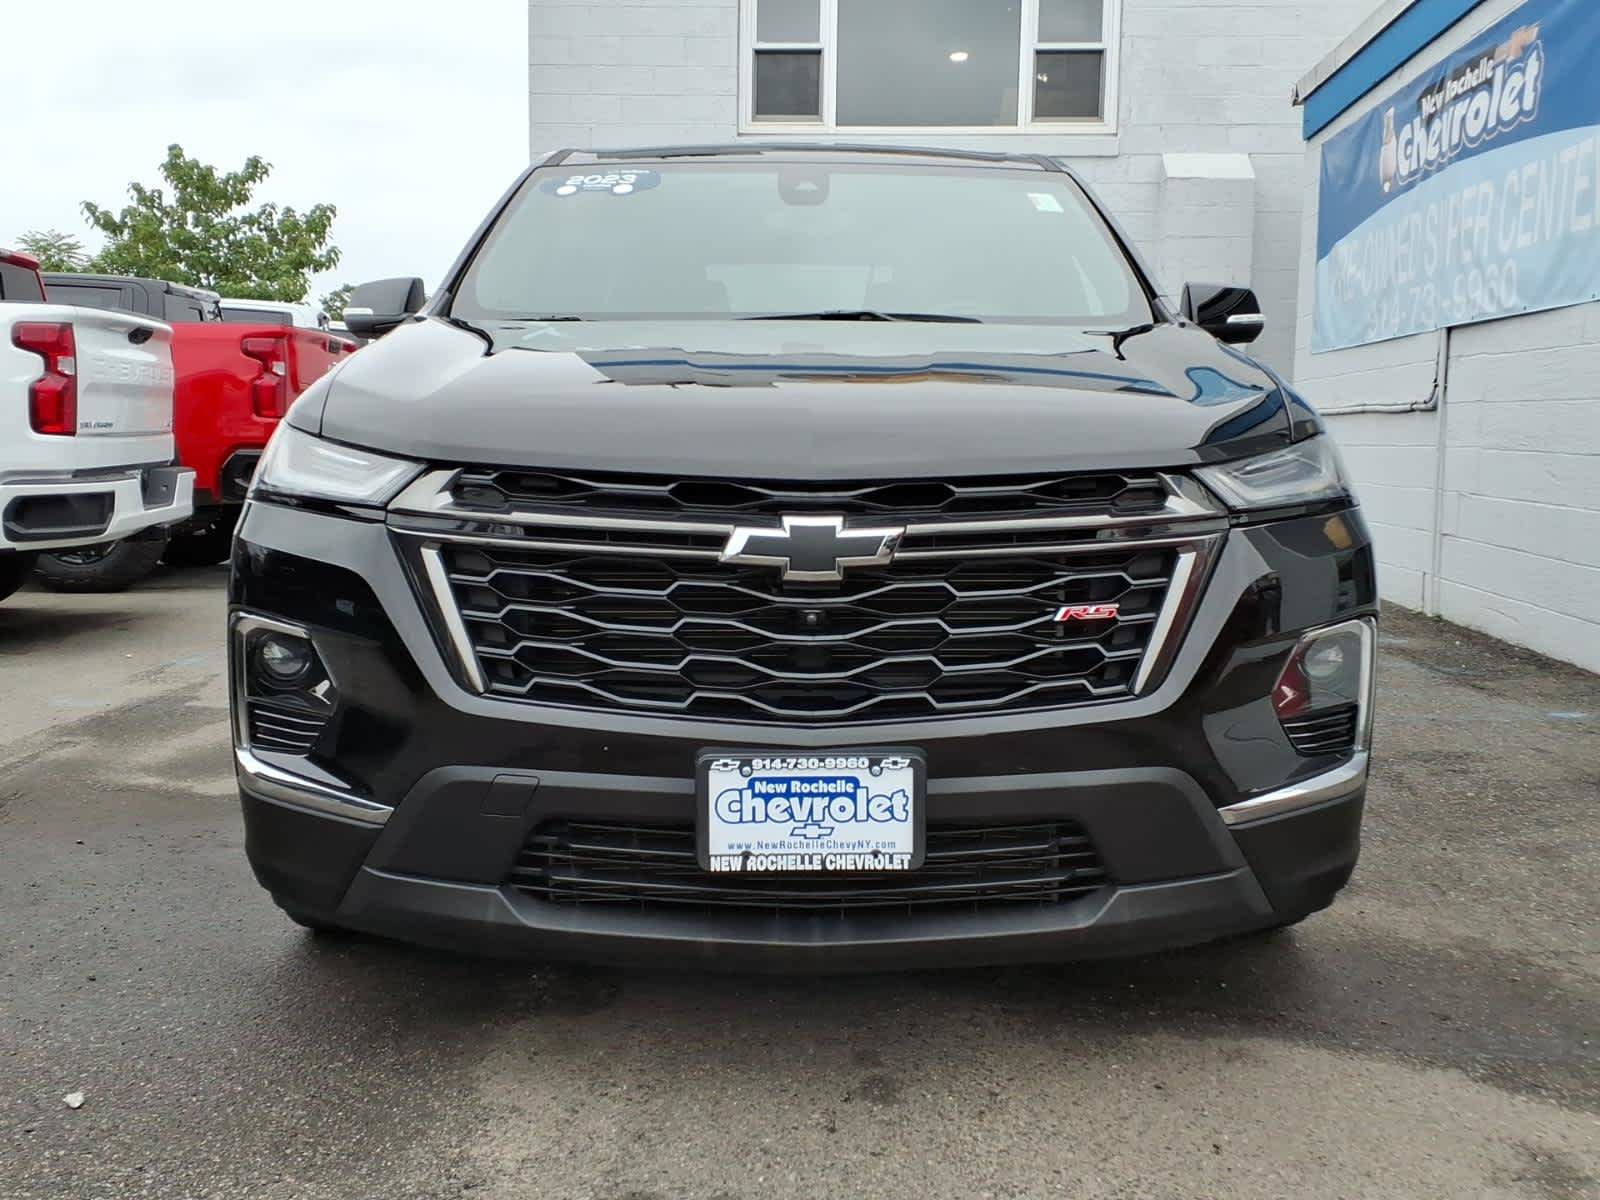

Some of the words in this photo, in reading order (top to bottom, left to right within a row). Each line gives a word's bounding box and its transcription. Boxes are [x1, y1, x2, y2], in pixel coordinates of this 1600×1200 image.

[1398, 49, 1540, 177] Chevrolet
[1424, 180, 1495, 276] SPER
[1053, 604, 1120, 622] RS
[751, 757, 870, 770] 914-730-9960
[754, 780, 788, 794] New
[791, 780, 854, 794] Rochelle
[715, 786, 909, 824] Chevrolet
[727, 839, 896, 852] www.NewRochelleChevyNY.com
[710, 854, 743, 871] NEW
[746, 854, 822, 871] ROCHELLE
[825, 853, 911, 870] CHEVROLET
